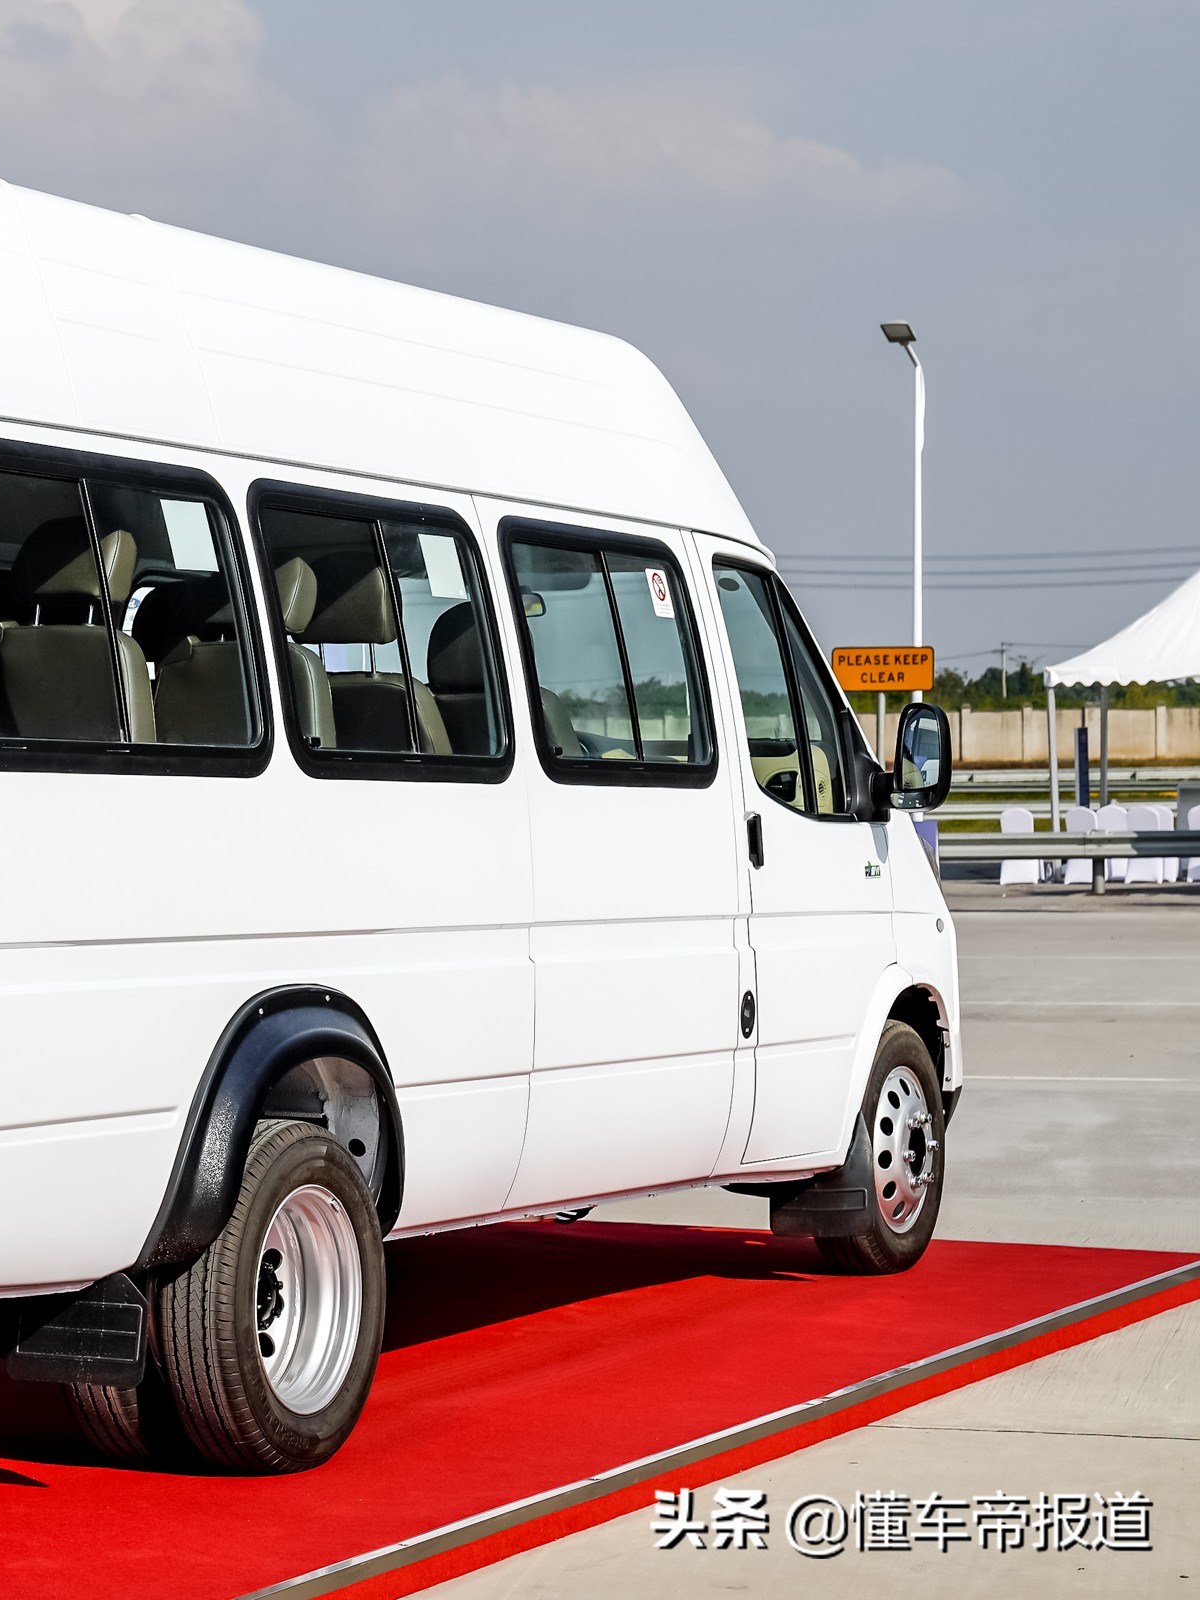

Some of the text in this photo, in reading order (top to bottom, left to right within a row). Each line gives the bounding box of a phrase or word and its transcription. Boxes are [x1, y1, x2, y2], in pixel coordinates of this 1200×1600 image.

[837, 654, 929, 666] PLEASE KEEP
[860, 672, 905, 683] CLEAR
